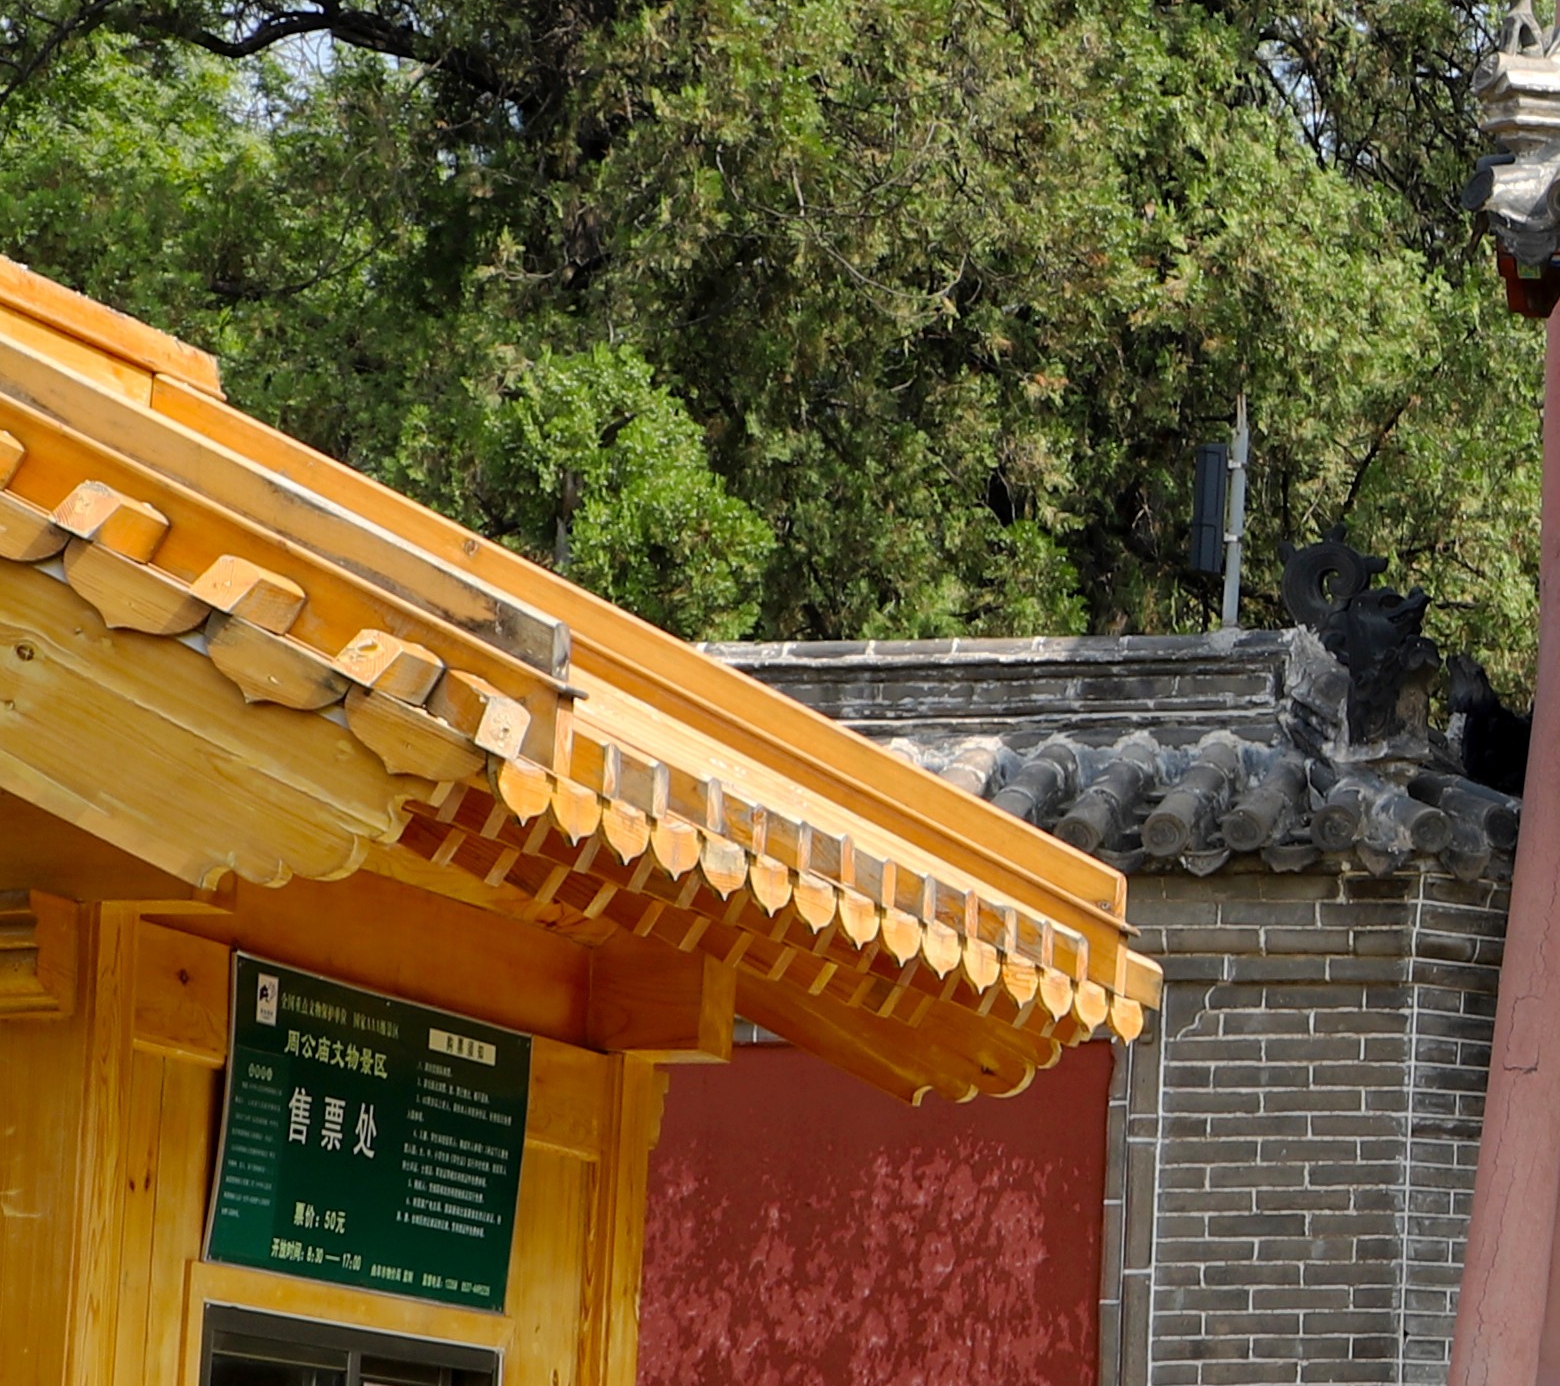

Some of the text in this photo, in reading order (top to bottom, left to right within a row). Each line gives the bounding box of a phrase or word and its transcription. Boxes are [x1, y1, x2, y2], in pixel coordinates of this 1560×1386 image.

[284, 1029, 388, 1079] 周公庙文物景区
[288, 1086, 377, 1159] 售票处
